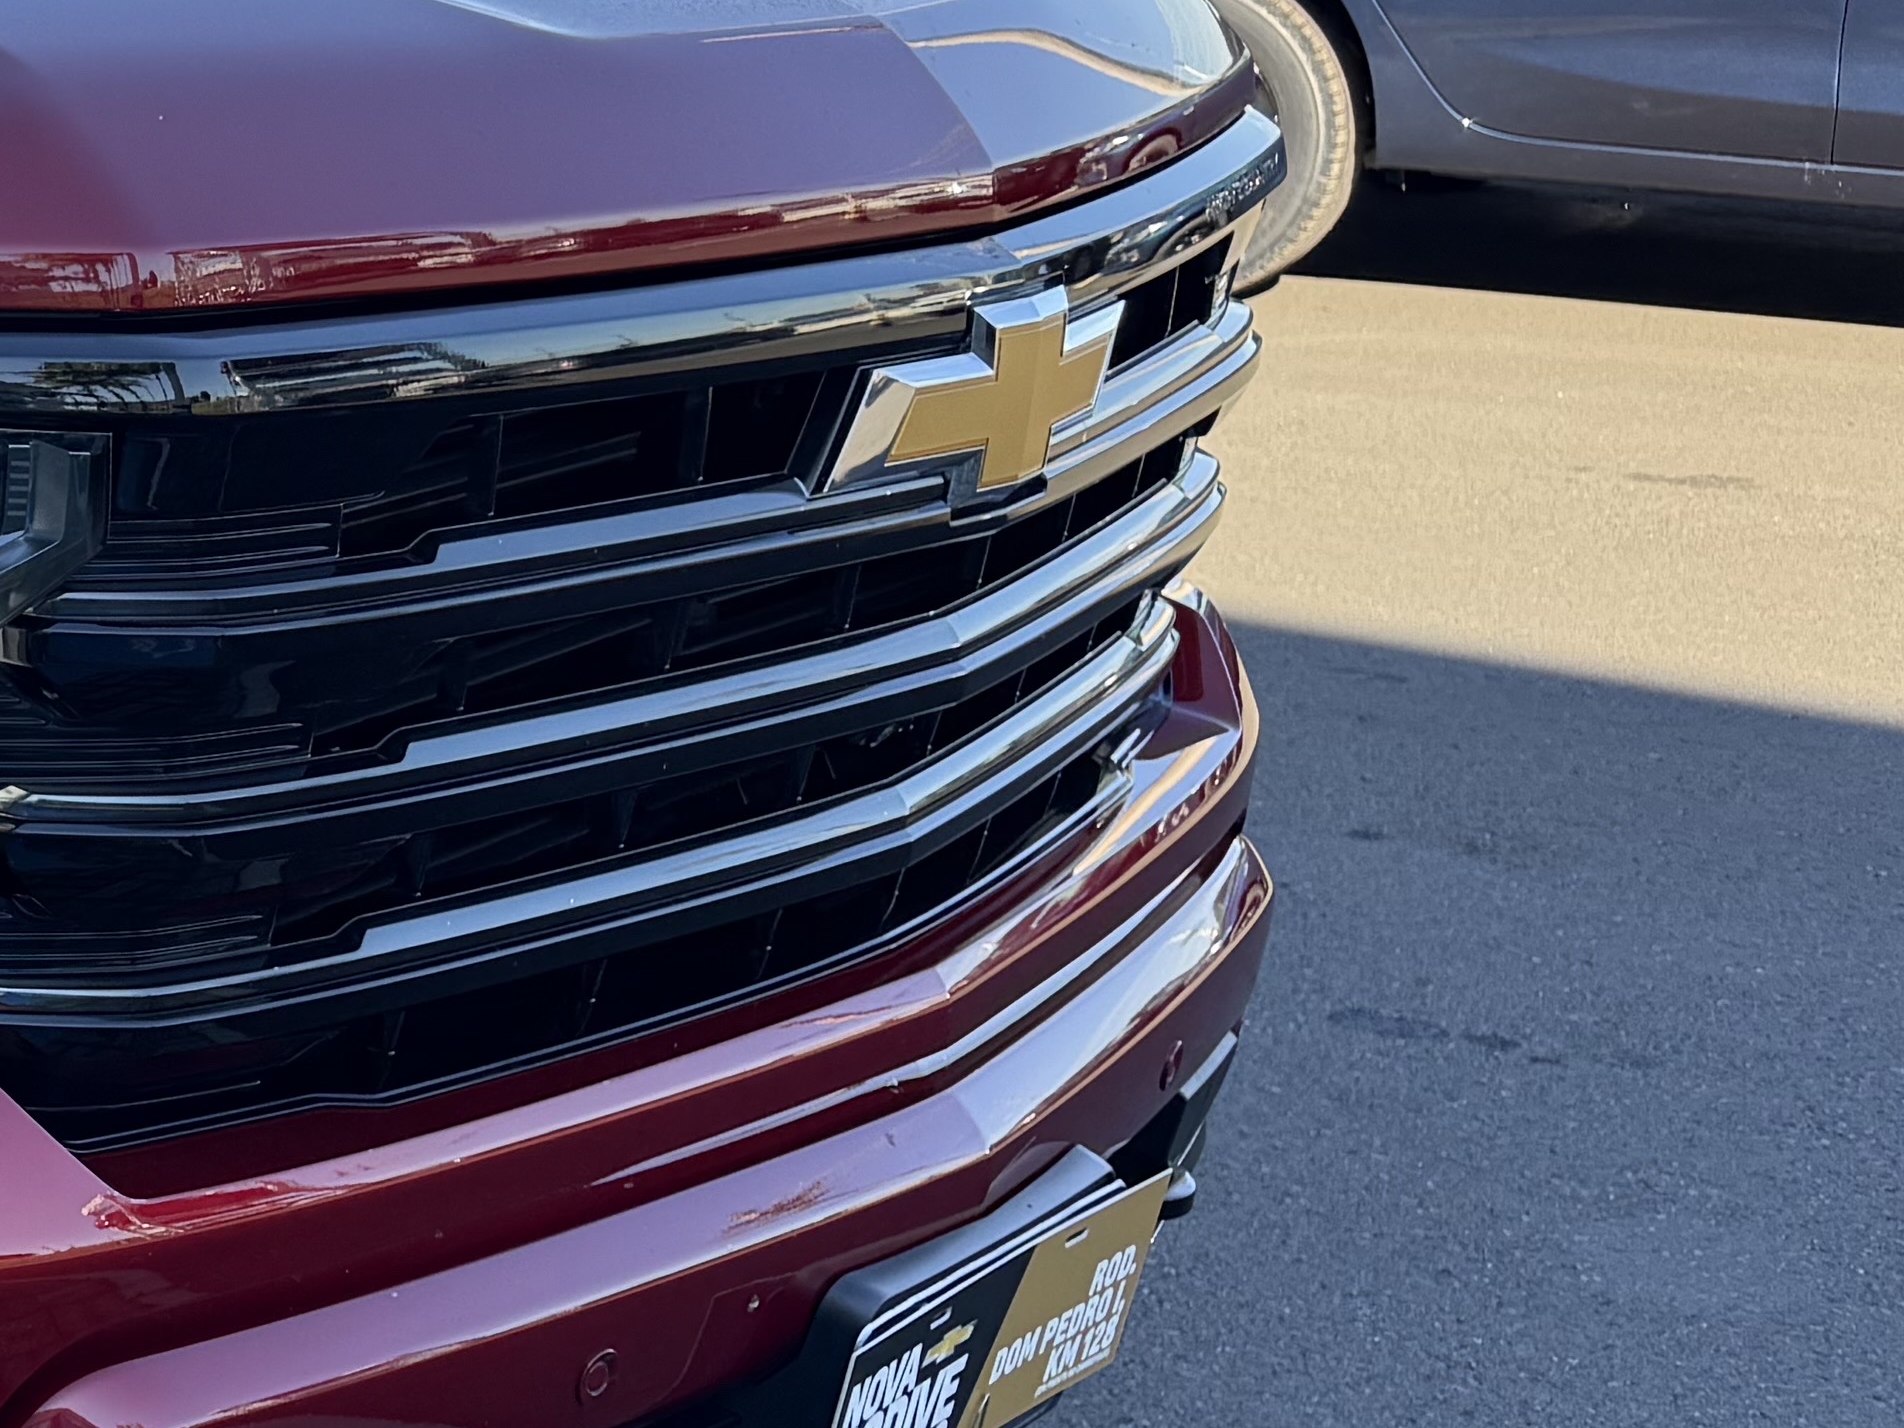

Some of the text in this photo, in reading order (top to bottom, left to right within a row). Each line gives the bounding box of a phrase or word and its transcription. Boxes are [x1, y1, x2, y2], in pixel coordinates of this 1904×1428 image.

[1088, 1244, 1137, 1297] ROD.
[988, 1325, 1043, 1386] DOM
[1038, 1286, 1114, 1355] PEDRO
[1042, 1334, 1083, 1383] KM
[1080, 1314, 1120, 1361] 128
